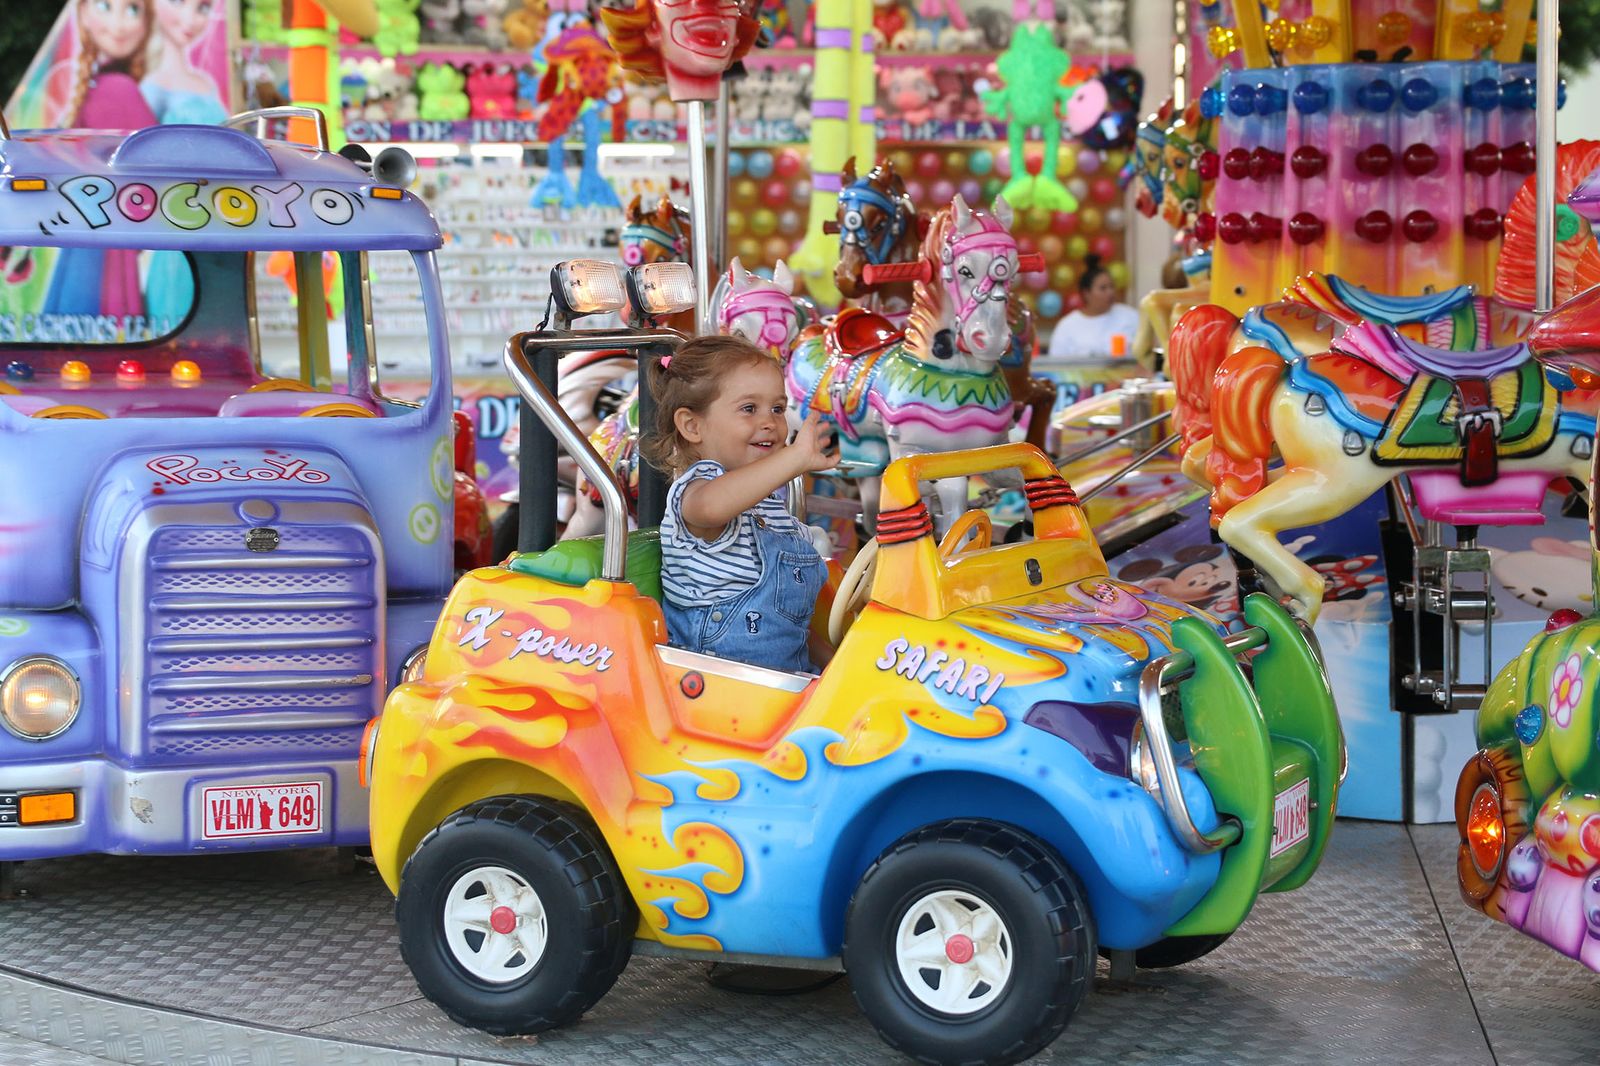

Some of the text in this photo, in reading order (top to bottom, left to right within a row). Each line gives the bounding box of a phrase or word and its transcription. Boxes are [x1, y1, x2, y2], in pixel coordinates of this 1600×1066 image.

[59, 175, 354, 230] POCOYO
[876, 638, 1005, 705] SAFARI
[211, 794, 314, 831] VLM 649
[221, 786, 311, 799] NEW YORK
